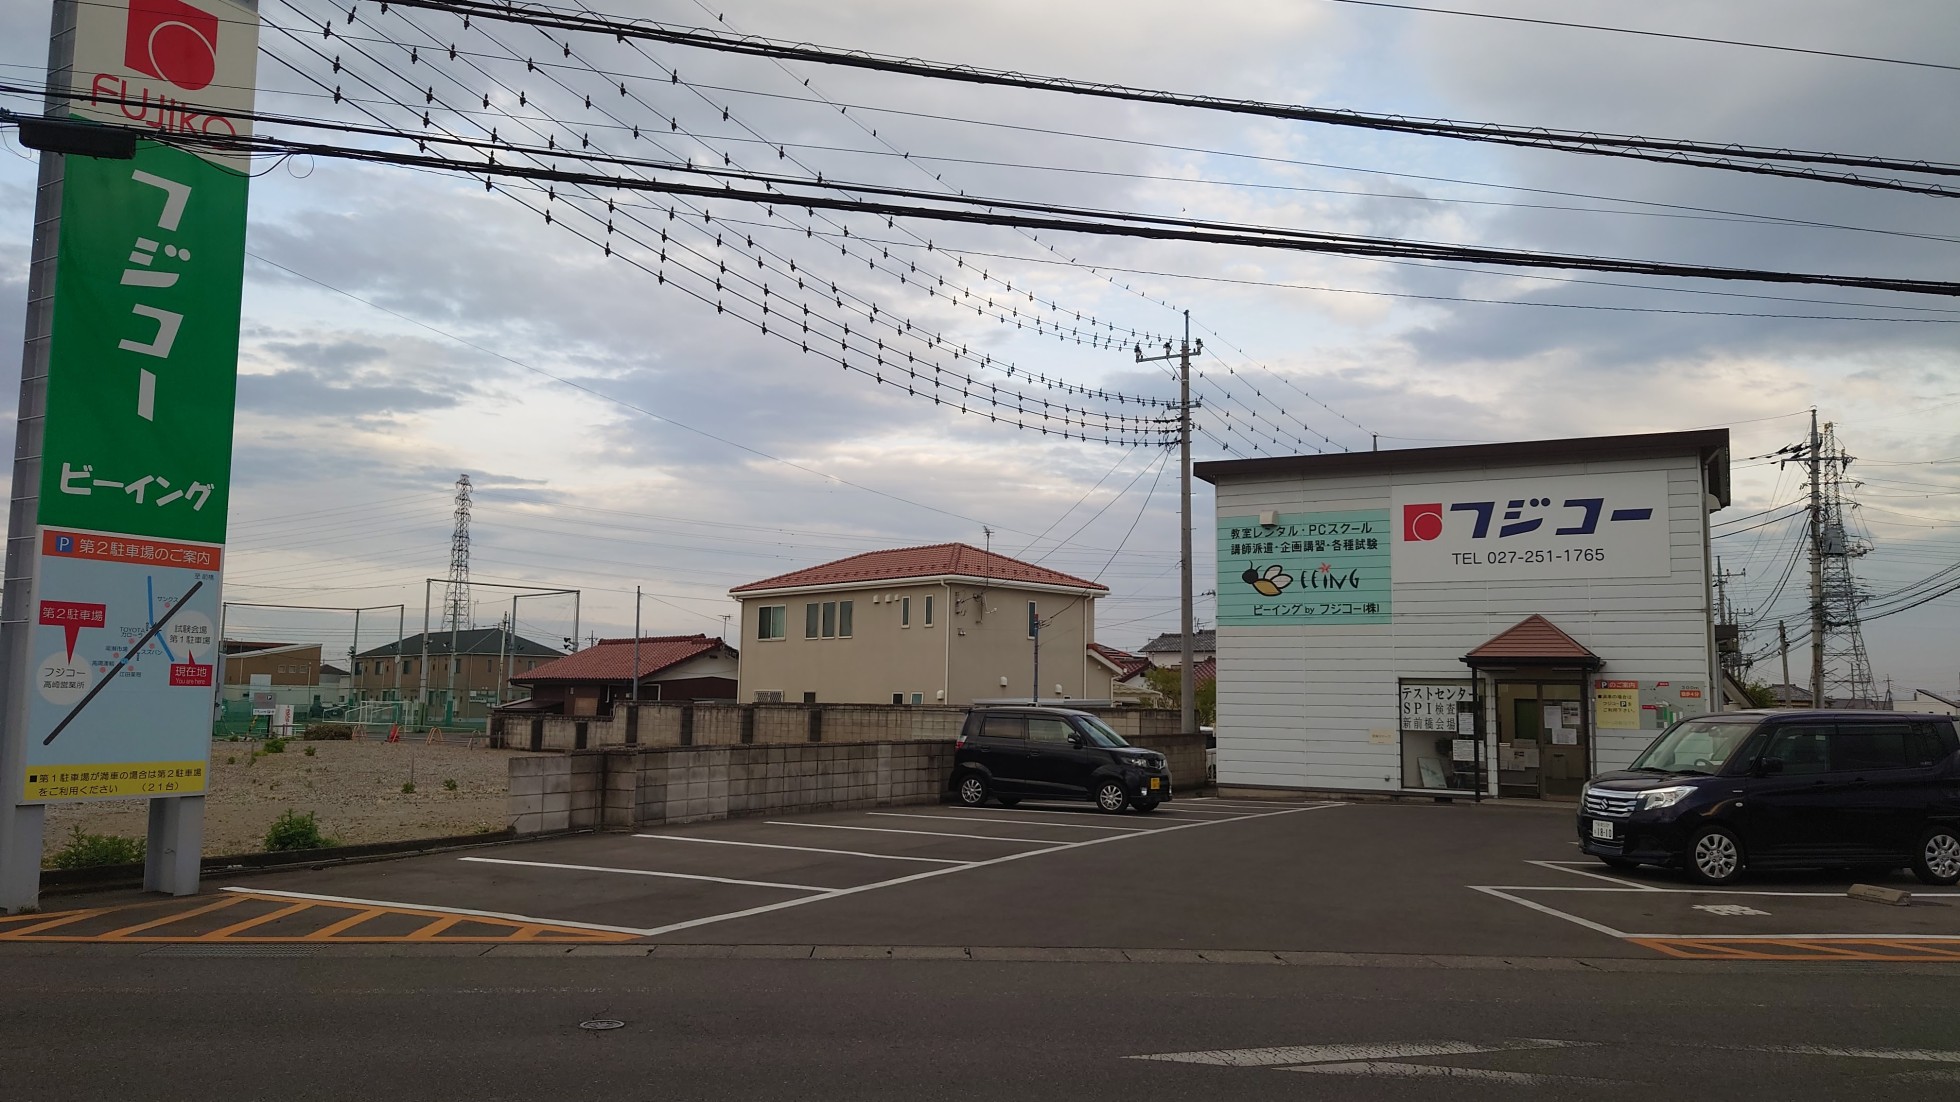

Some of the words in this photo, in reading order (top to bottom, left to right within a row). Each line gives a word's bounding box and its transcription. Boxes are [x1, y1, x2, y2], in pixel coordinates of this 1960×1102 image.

[118, 170, 192, 422] フジコー
[60, 462, 214, 511] ビーイング
[1450, 496, 1653, 539] フジコー
[79, 538, 210, 565] 第2駐車場のご案内
[1452, 551, 1482, 565] TEL
[1488, 548, 1605, 565] 027-251-1765
[43, 607, 103, 621] 第2駐車場
[1253, 603, 1303, 616] ビーイング
[1305, 606, 1315, 615] by
[174, 625, 208, 634] 試験会場
[170, 635, 211, 644] 第1駐車場
[44, 667, 86, 678] フジコー
[175, 667, 207, 677] 現在地
[43, 681, 85, 690] 高崎営業所
[1403, 716, 1456, 730] 新前橋会場
[38, 784, 118, 797] をご利用ください
